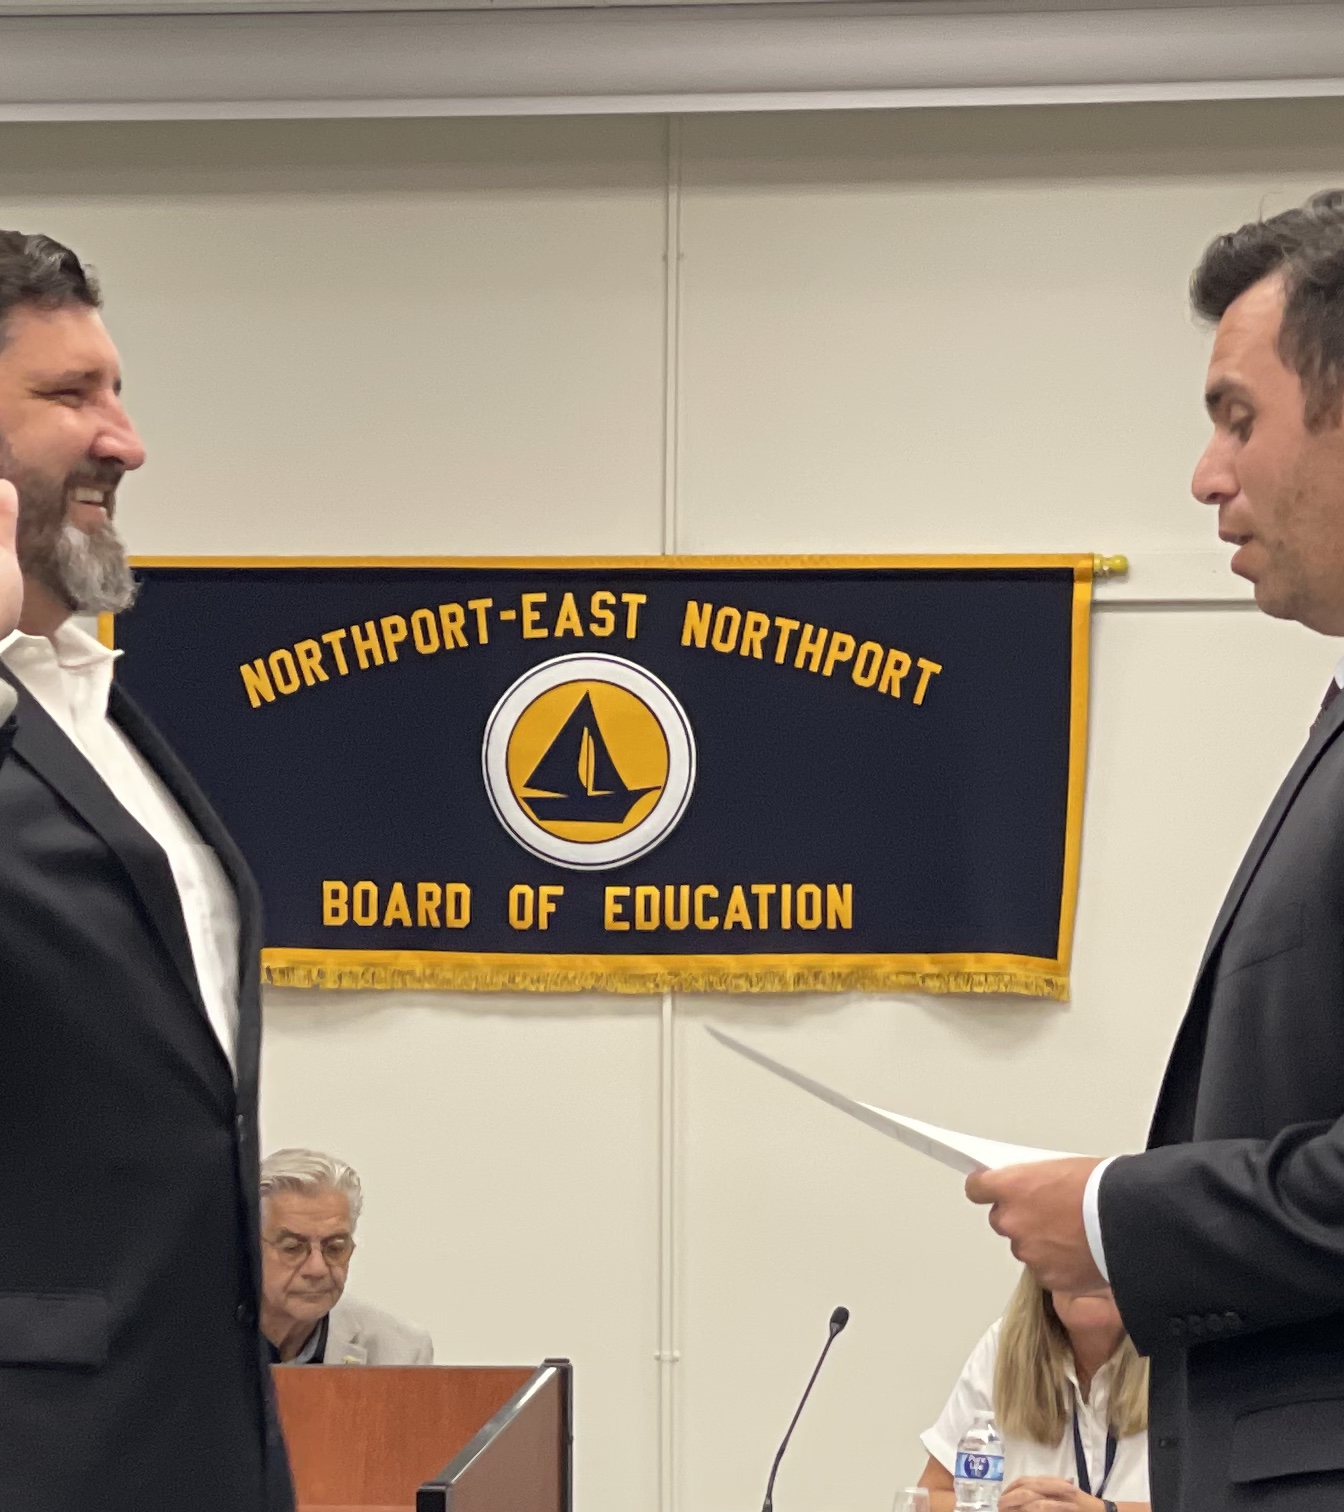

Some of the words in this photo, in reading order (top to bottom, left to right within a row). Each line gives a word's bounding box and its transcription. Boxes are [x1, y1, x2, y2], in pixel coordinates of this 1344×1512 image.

[239, 590, 647, 709] NORTHPORT-EAST
[680, 599, 943, 706] NORTHPORT
[322, 880, 471, 930] BOARD
[508, 883, 564, 931] OF
[604, 883, 854, 931] EDUCATION
